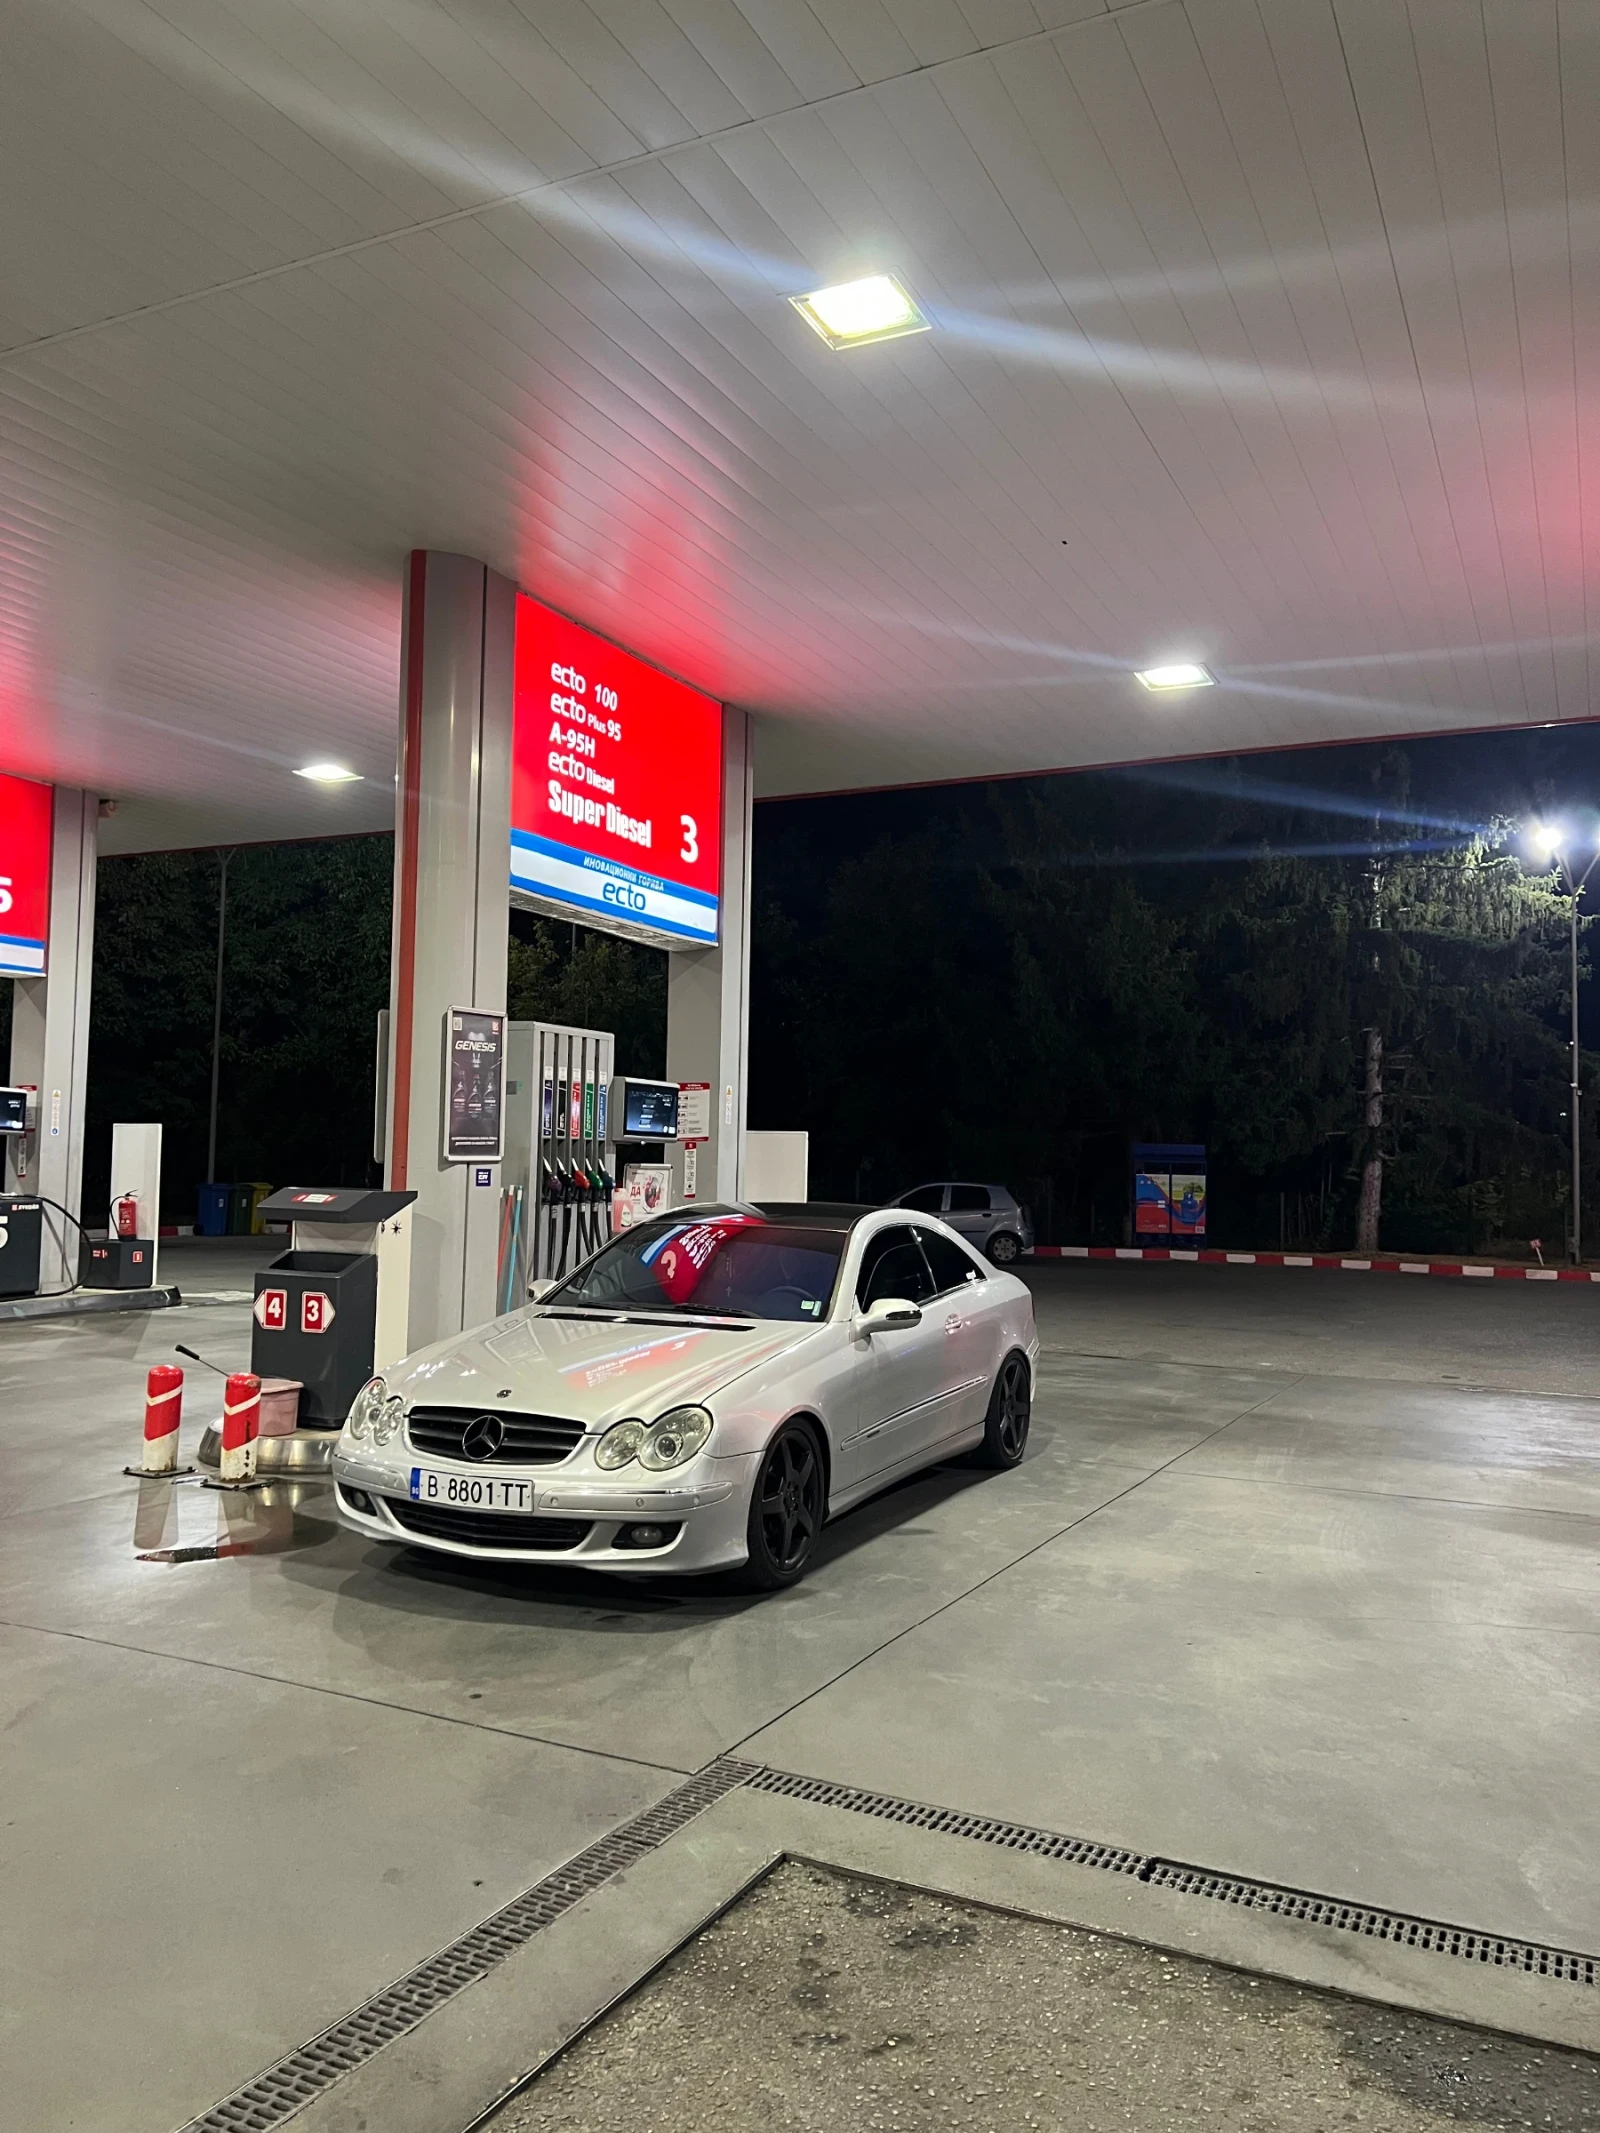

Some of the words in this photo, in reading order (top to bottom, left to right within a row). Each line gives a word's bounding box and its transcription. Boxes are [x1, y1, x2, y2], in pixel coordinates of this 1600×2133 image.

[550, 662, 586, 694] ecto
[594, 683, 618, 712] 100
[550, 692, 587, 724] ecto
[587, 713, 607, 734] Plus
[607, 719, 622, 742] 95
[548, 721, 596, 758] A-95H
[548, 751, 586, 781] ecto
[586, 766, 615, 795] Diesel
[548, 779, 605, 827] Super
[606, 802, 652, 848] Diesel
[680, 814, 699, 863] 3
[583, 856, 637, 882] ИНОВАЦИОННИ
[638, 875, 664, 892] ГОРИВА
[602, 881, 646, 911] ecto
[454, 1040, 497, 1053] GENESIS
[267, 1297, 282, 1319] 4
[306, 1300, 320, 1322] 3
[428, 1474, 438, 1498] B
[447, 1477, 494, 1506] 8801
[500, 1482, 529, 1508] TT
